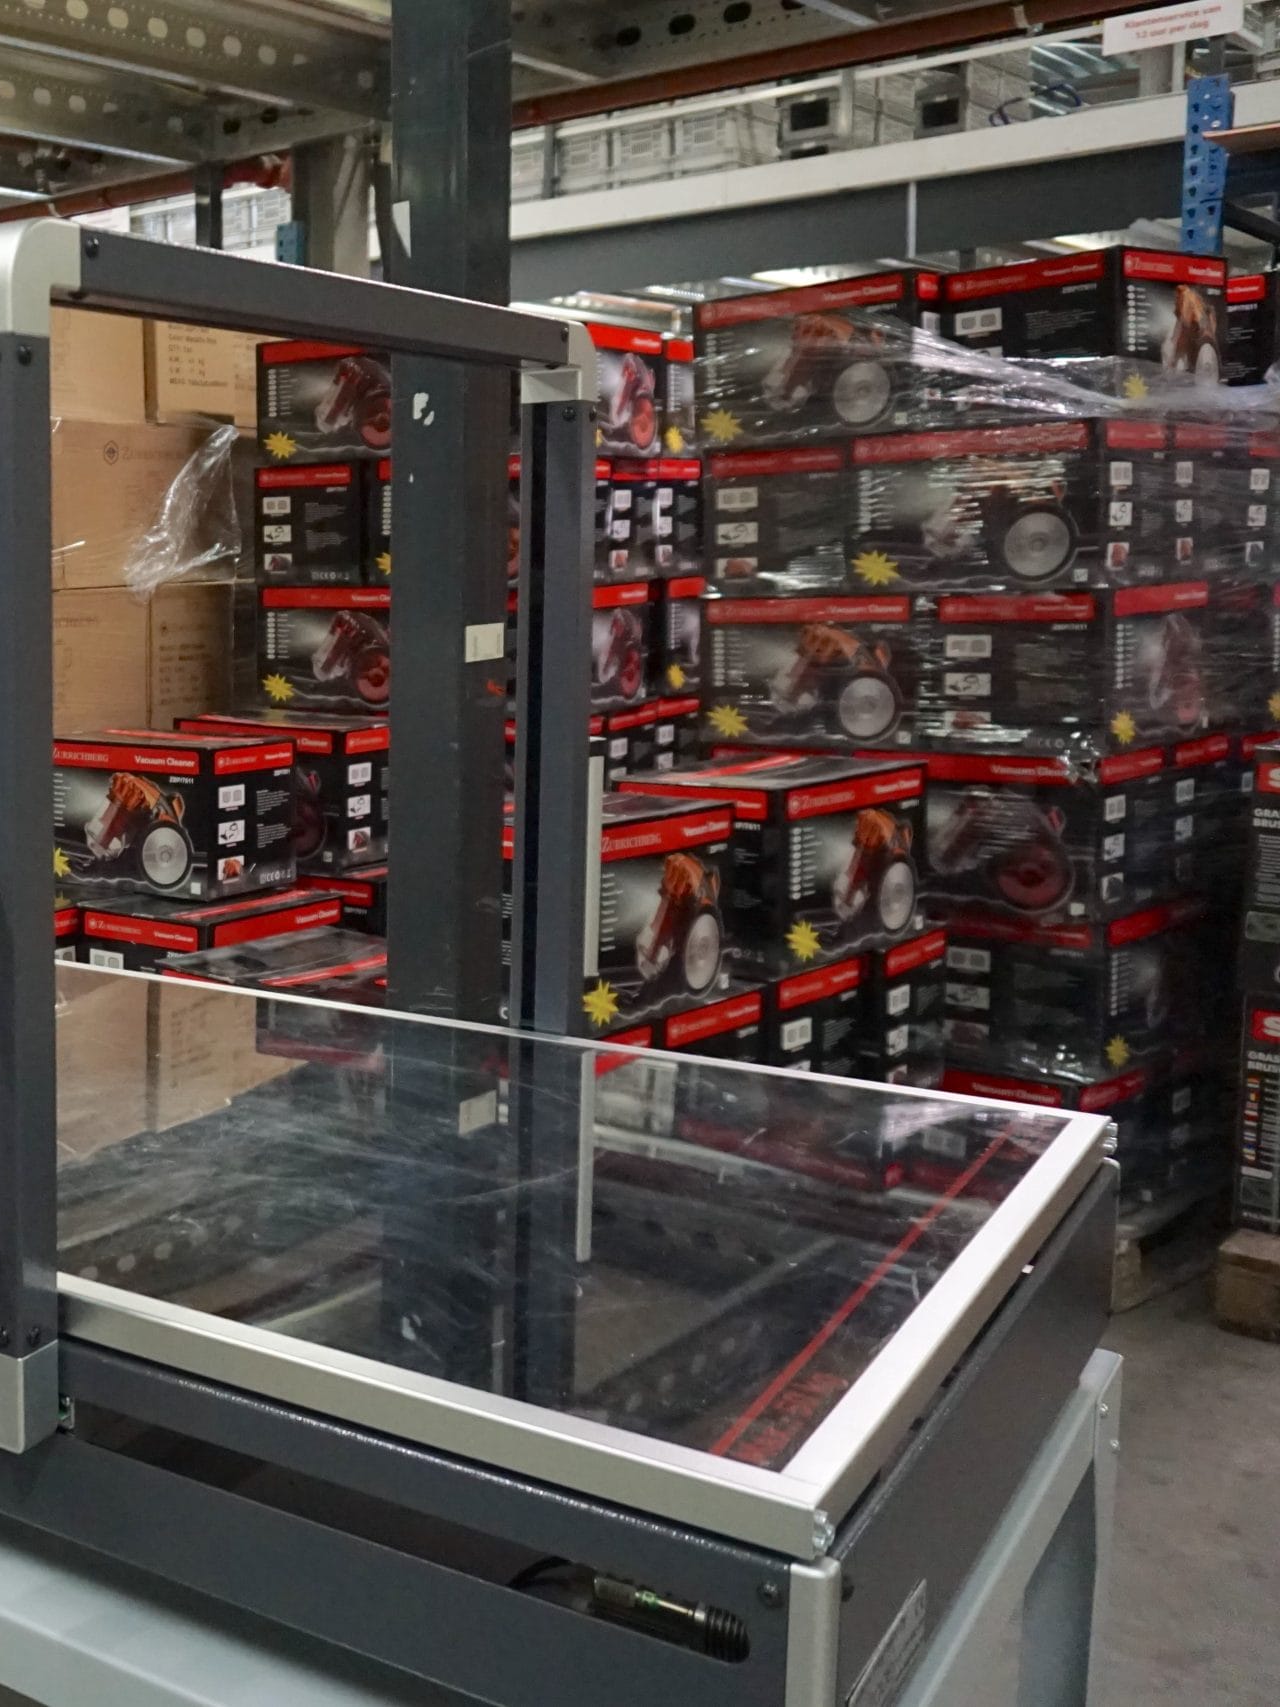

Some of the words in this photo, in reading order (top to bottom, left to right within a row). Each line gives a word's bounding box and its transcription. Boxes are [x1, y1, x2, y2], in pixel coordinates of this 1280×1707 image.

[134, 754, 166, 766] Vacuum
[166, 756, 196, 768] Cleaner
[990, 764, 1035, 776] Vacuum
